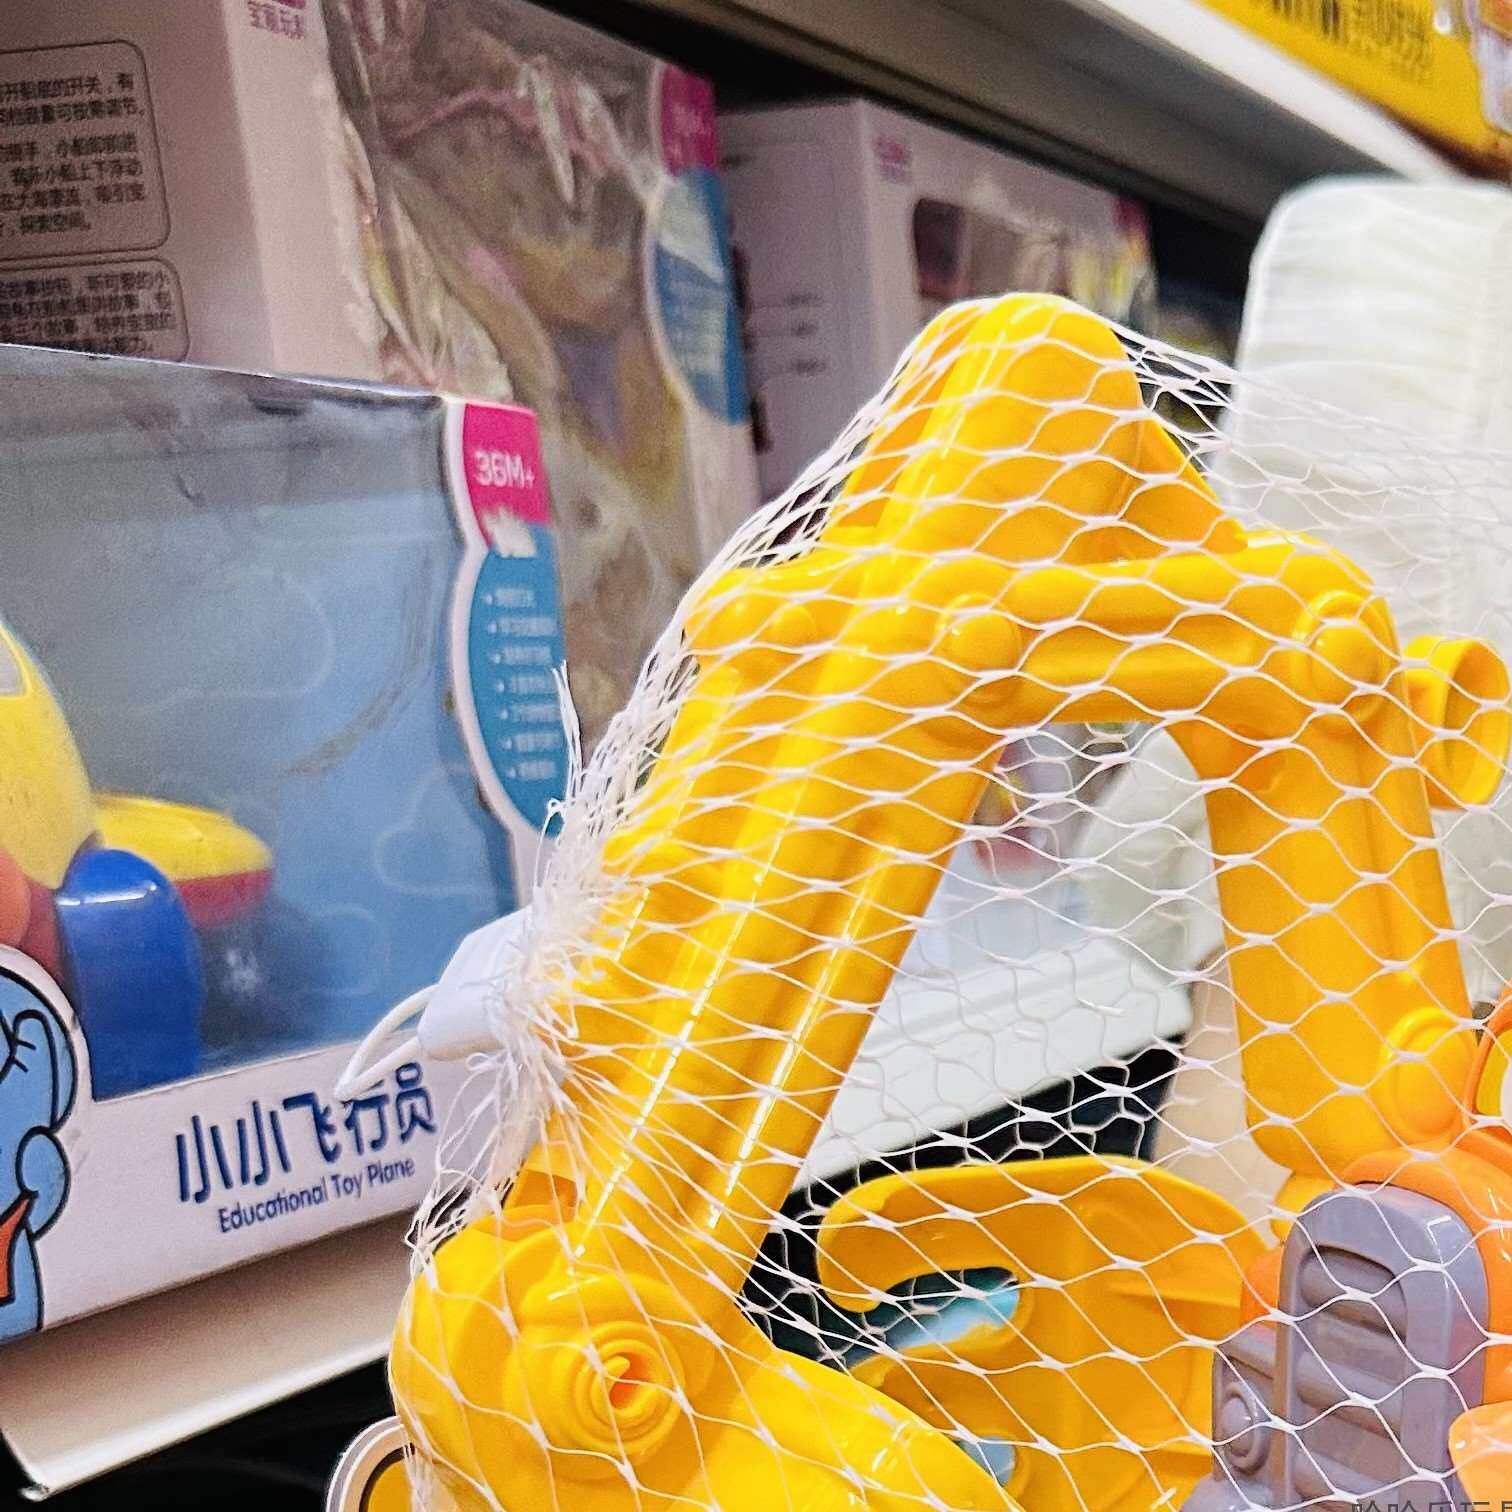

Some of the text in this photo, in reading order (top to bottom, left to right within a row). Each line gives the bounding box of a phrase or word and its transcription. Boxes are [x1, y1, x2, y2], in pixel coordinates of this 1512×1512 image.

[474, 448, 536, 489] 36M+
[176, 1061, 437, 1204] 小小飞行员
[218, 1156, 416, 1233] Educational Toy Plane
